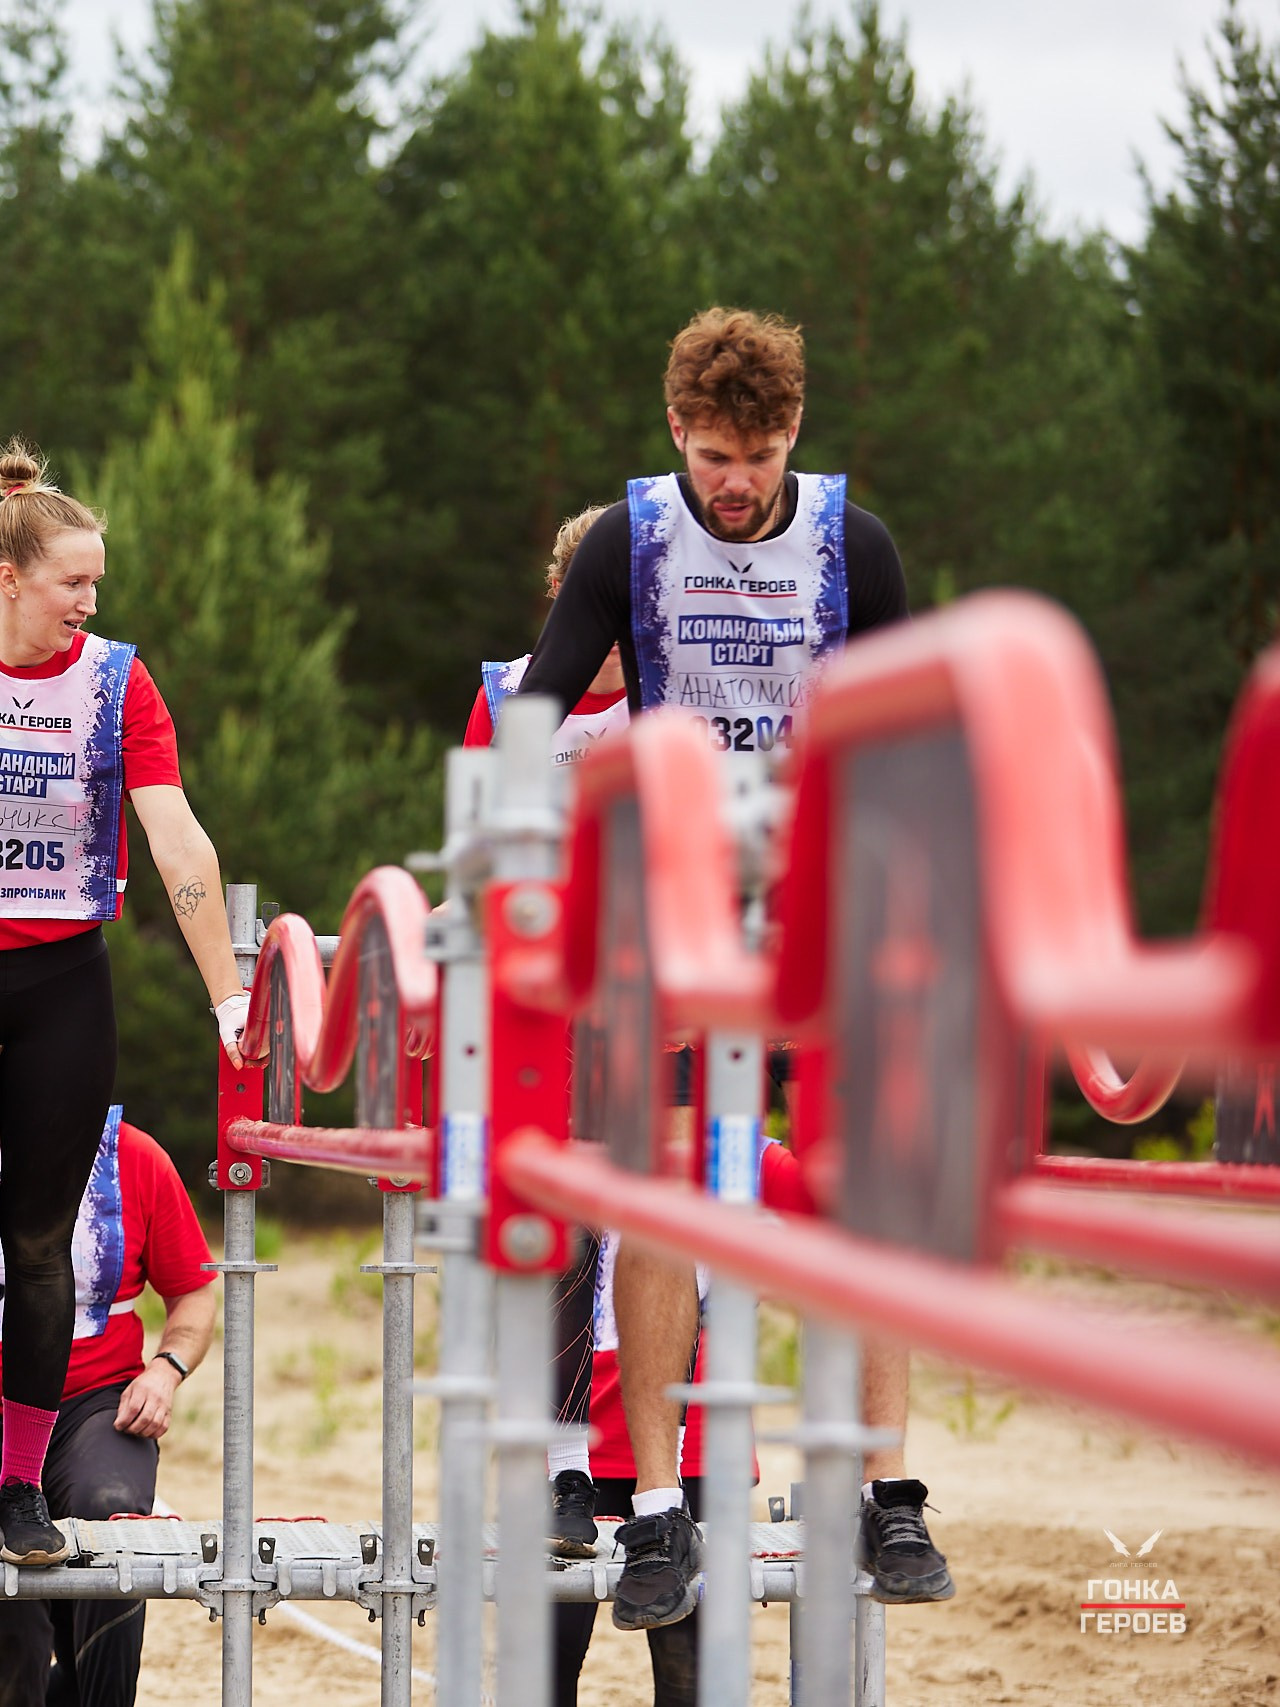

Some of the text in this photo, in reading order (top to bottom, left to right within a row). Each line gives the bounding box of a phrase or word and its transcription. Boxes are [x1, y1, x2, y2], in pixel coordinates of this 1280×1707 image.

[684, 576, 797, 593] ГОНКА ГЕРОЕВ
[680, 617, 802, 644] КОМАНДНЫЙ
[714, 643, 770, 664] СТАРТ
[20, 715, 72, 729] ГЕРОЕВ
[551, 747, 591, 763] ОНКА
